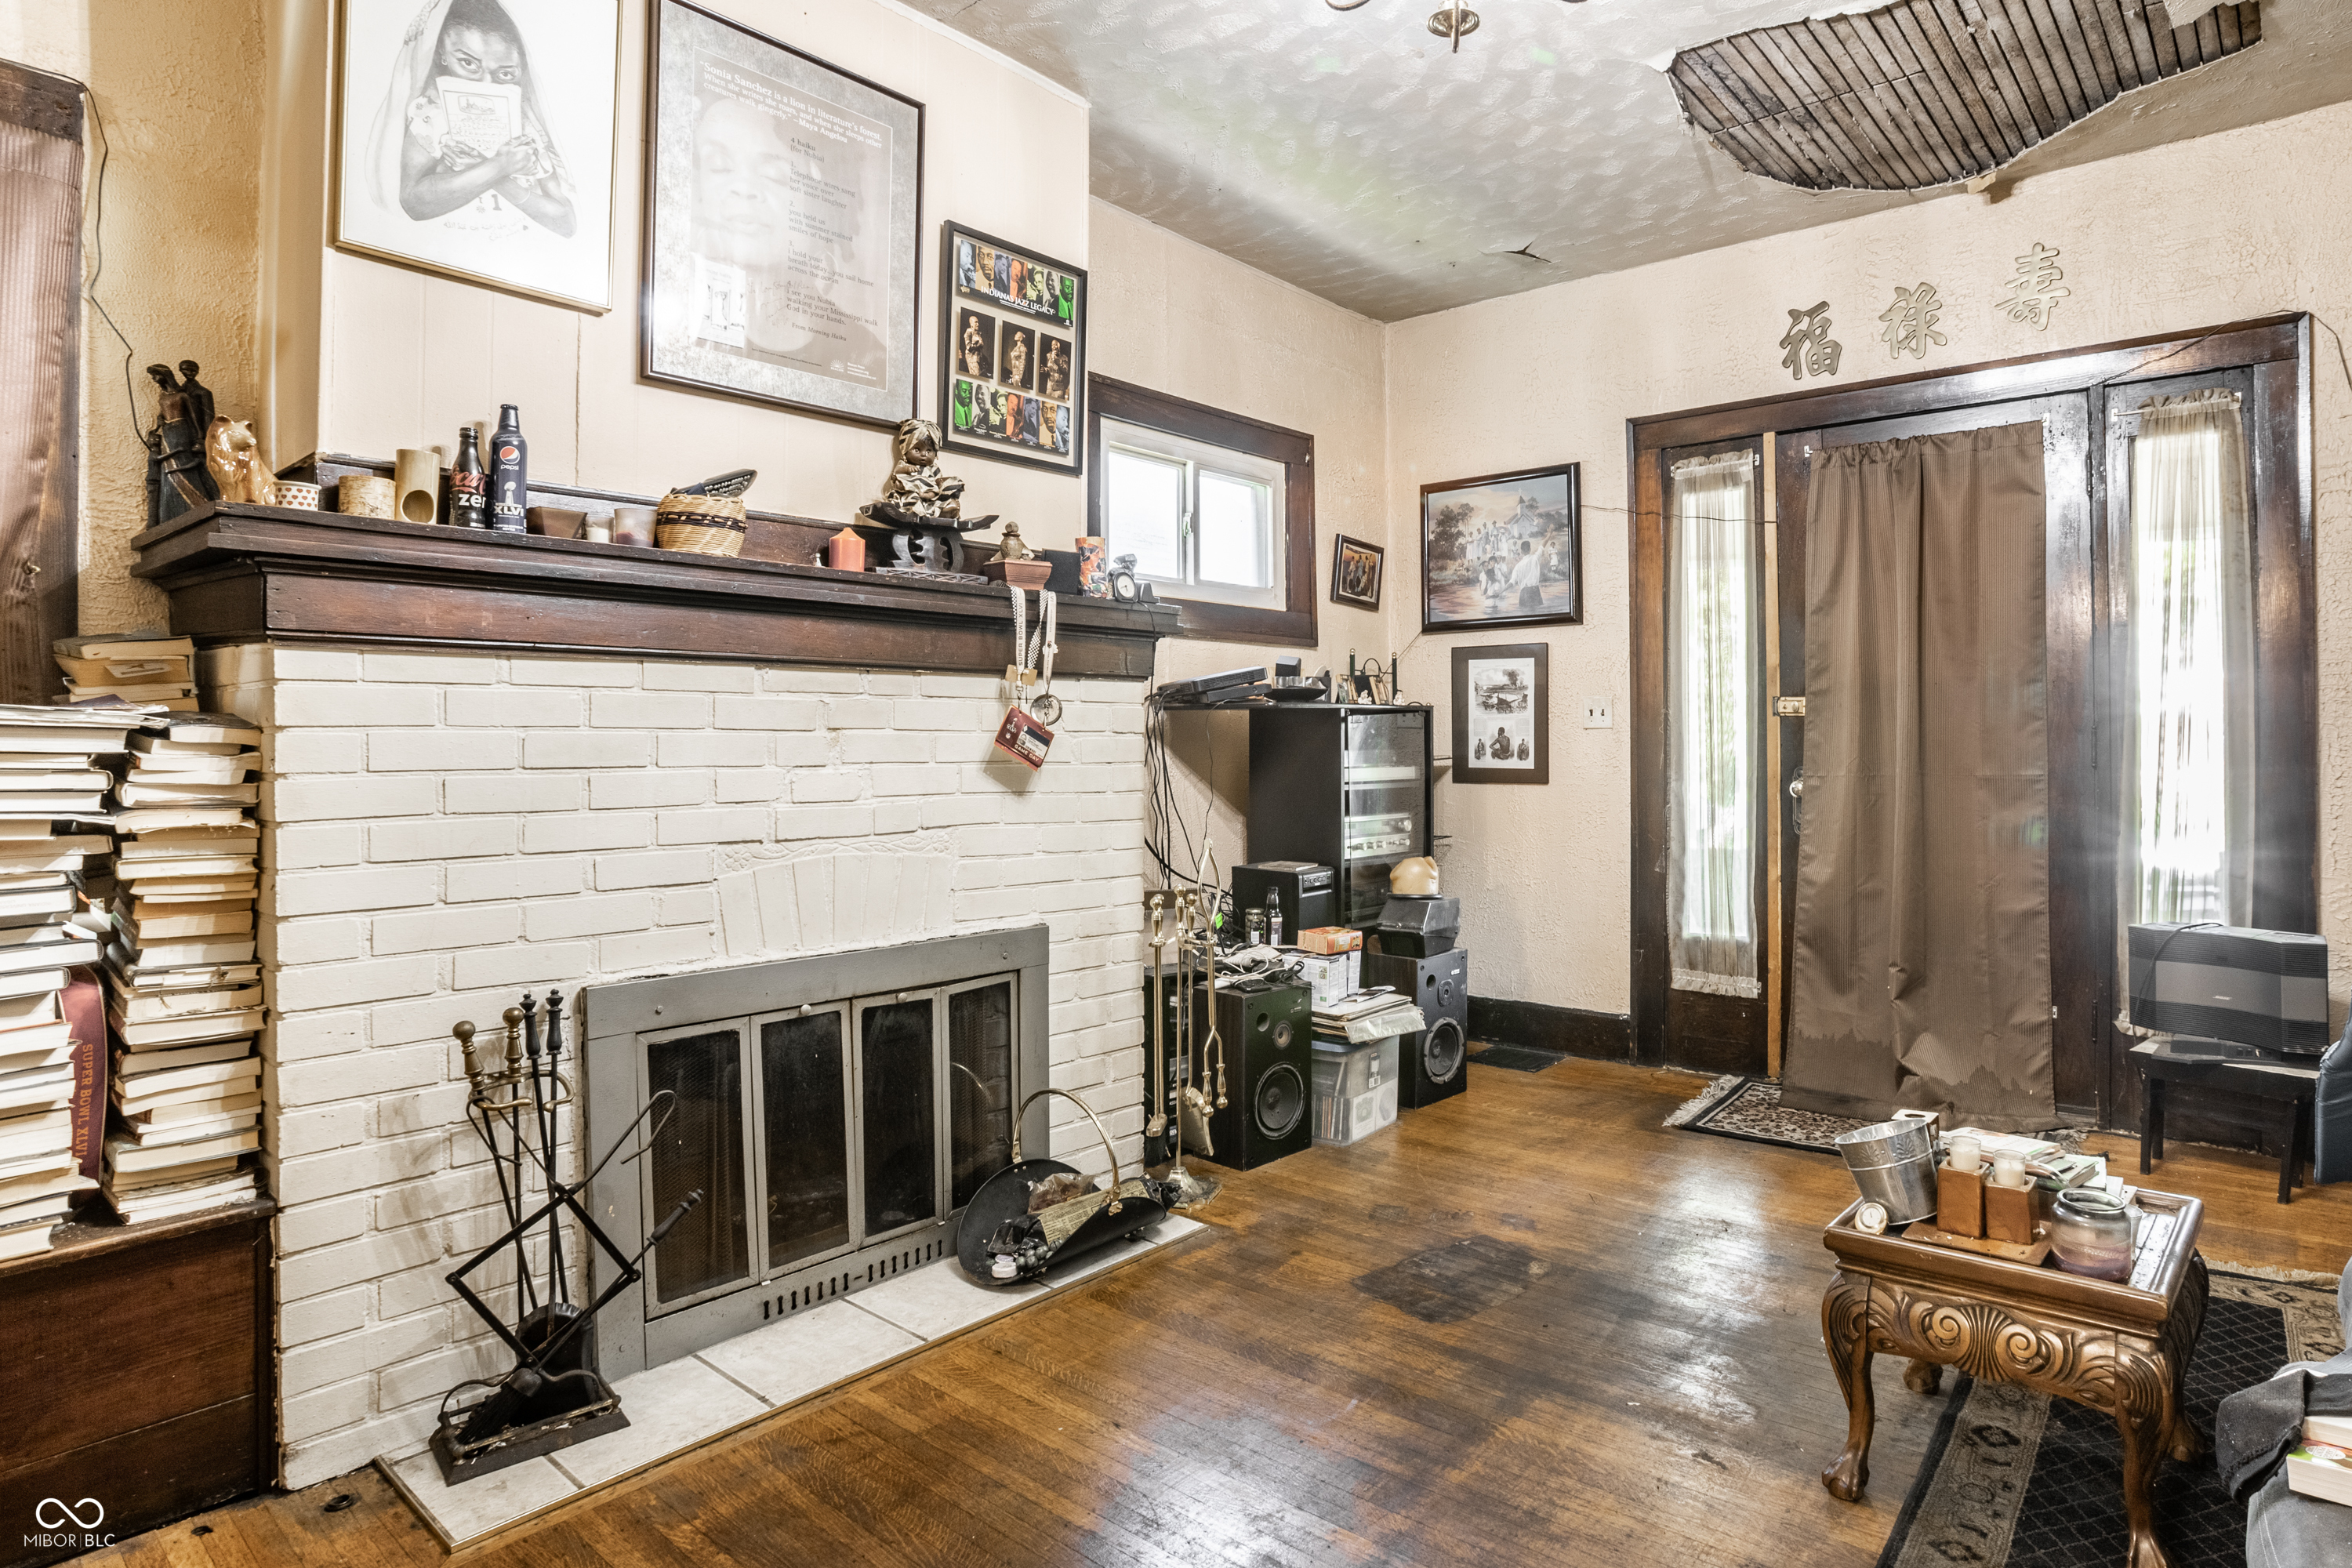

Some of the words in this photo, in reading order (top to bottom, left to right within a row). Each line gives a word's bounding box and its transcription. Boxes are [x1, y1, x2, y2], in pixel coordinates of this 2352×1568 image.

[704, 72, 725, 87] When
[728, 82, 740, 93] she
[742, 88, 763, 102] writes
[765, 96, 776, 107] she
[779, 103, 797, 116] roars,
[800, 111, 811, 121] and
[818, 118, 831, 129] when
[833, 124, 844, 133] she
[845, 129, 864, 143] sleeps
[866, 136, 881, 149] other
[704, 81, 736, 100] creatures
[739, 95, 756, 107] walk
[820, 126, 848, 145] Angelou
[735, 74, 772, 97] Sanchez
[775, 91, 781, 101] is
[790, 96, 806, 111] lion
[808, 104, 815, 114] in
[818, 108, 858, 132] literature's
[860, 125, 882, 142] forest.
[790, 143, 802, 155] (for
[804, 149, 825, 164] Nubia)
[797, 139, 816, 152] haiku
[789, 168, 822, 187] Telephone
[824, 180, 840, 192] wires
[841, 187, 856, 199] sang
[789, 176, 800, 185] her
[802, 180, 818, 192] voice
[820, 187, 834, 198] over
[789, 183, 801, 194] soft
[804, 188, 820, 200] sister
[822, 195, 847, 211] laughter
[789, 209, 801, 220] you
[804, 212, 816, 223] held
[788, 223, 808, 236] smiles
[810, 230, 818, 239] of
[818, 233, 833, 245] hope
[789, 216, 803, 226] with
[805, 222, 830, 235] summer
[831, 229, 853, 243] stained
[793, 249, 806, 259] hold
[808, 255, 823, 266] your
[787, 264, 808, 275] across
[809, 270, 818, 278] the
[821, 274, 839, 285] ocean
[788, 255, 808, 267] breath
[846, 273, 856, 282] sail
[858, 277, 874, 288] home
[787, 295, 813, 310] walking
[814, 304, 829, 314] your
[830, 307, 862, 324] Mississippi
[865, 317, 878, 327] walk
[804, 293, 815, 303] you
[817, 296, 836, 307] Nubia
[981, 285, 1014, 302] INDIANA'S
[1014, 296, 1029, 307] JAZZ
[1030, 303, 1054, 315] LEGACY
[786, 303, 800, 313] God
[811, 310, 825, 321] your
[826, 314, 847, 325] hands.
[792, 322, 806, 332] From
[808, 326, 830, 339] Morning
[831, 332, 847, 342] Haiku
[458, 494, 486, 508] zer
[494, 506, 524, 517] XLVI
[1014, 745, 1028, 755] GAME
[1029, 753, 1040, 761] DAY
[82, 1044, 93, 1086] SUPER
[78, 1088, 92, 1125] BOWL
[75, 1127, 89, 1156] XLVI
